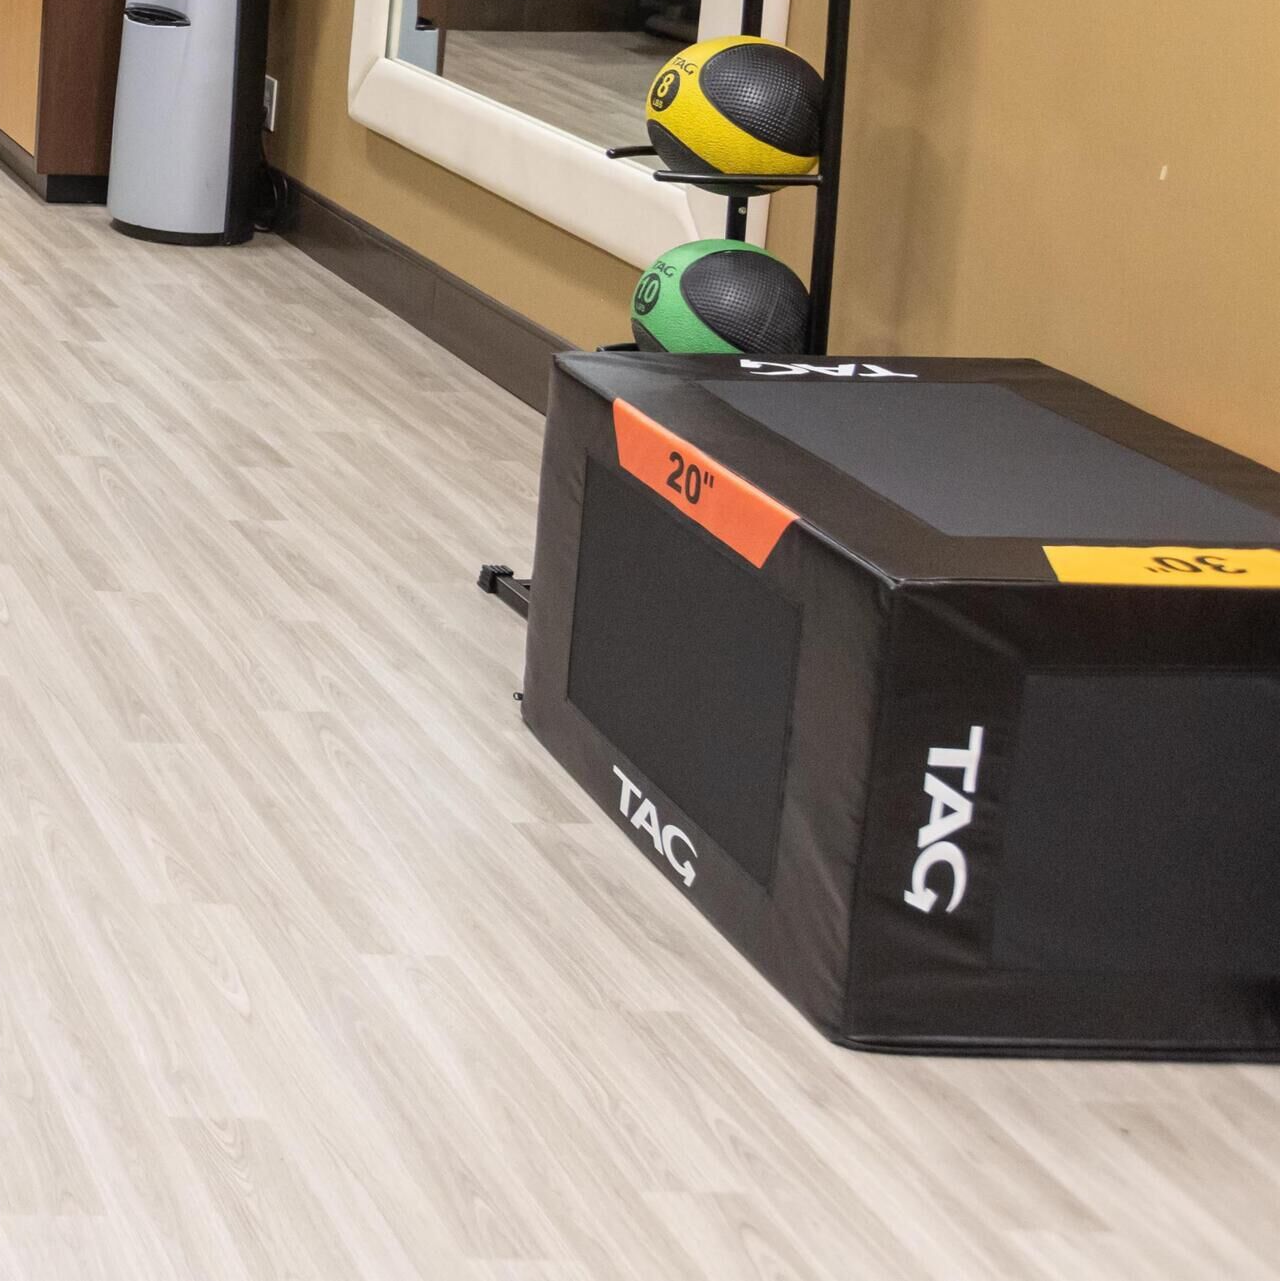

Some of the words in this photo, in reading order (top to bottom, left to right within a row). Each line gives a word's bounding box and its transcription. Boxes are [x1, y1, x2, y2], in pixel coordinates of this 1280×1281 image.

[673, 56, 699, 76] TAG
[657, 73, 675, 98] 8
[653, 260, 677, 278] TAG
[638, 277, 659, 303] 10
[666, 451, 715, 505] 20"
[1143, 555, 1248, 574] 30"
[613, 764, 698, 888] TAG
[903, 725, 984, 914] TAG
